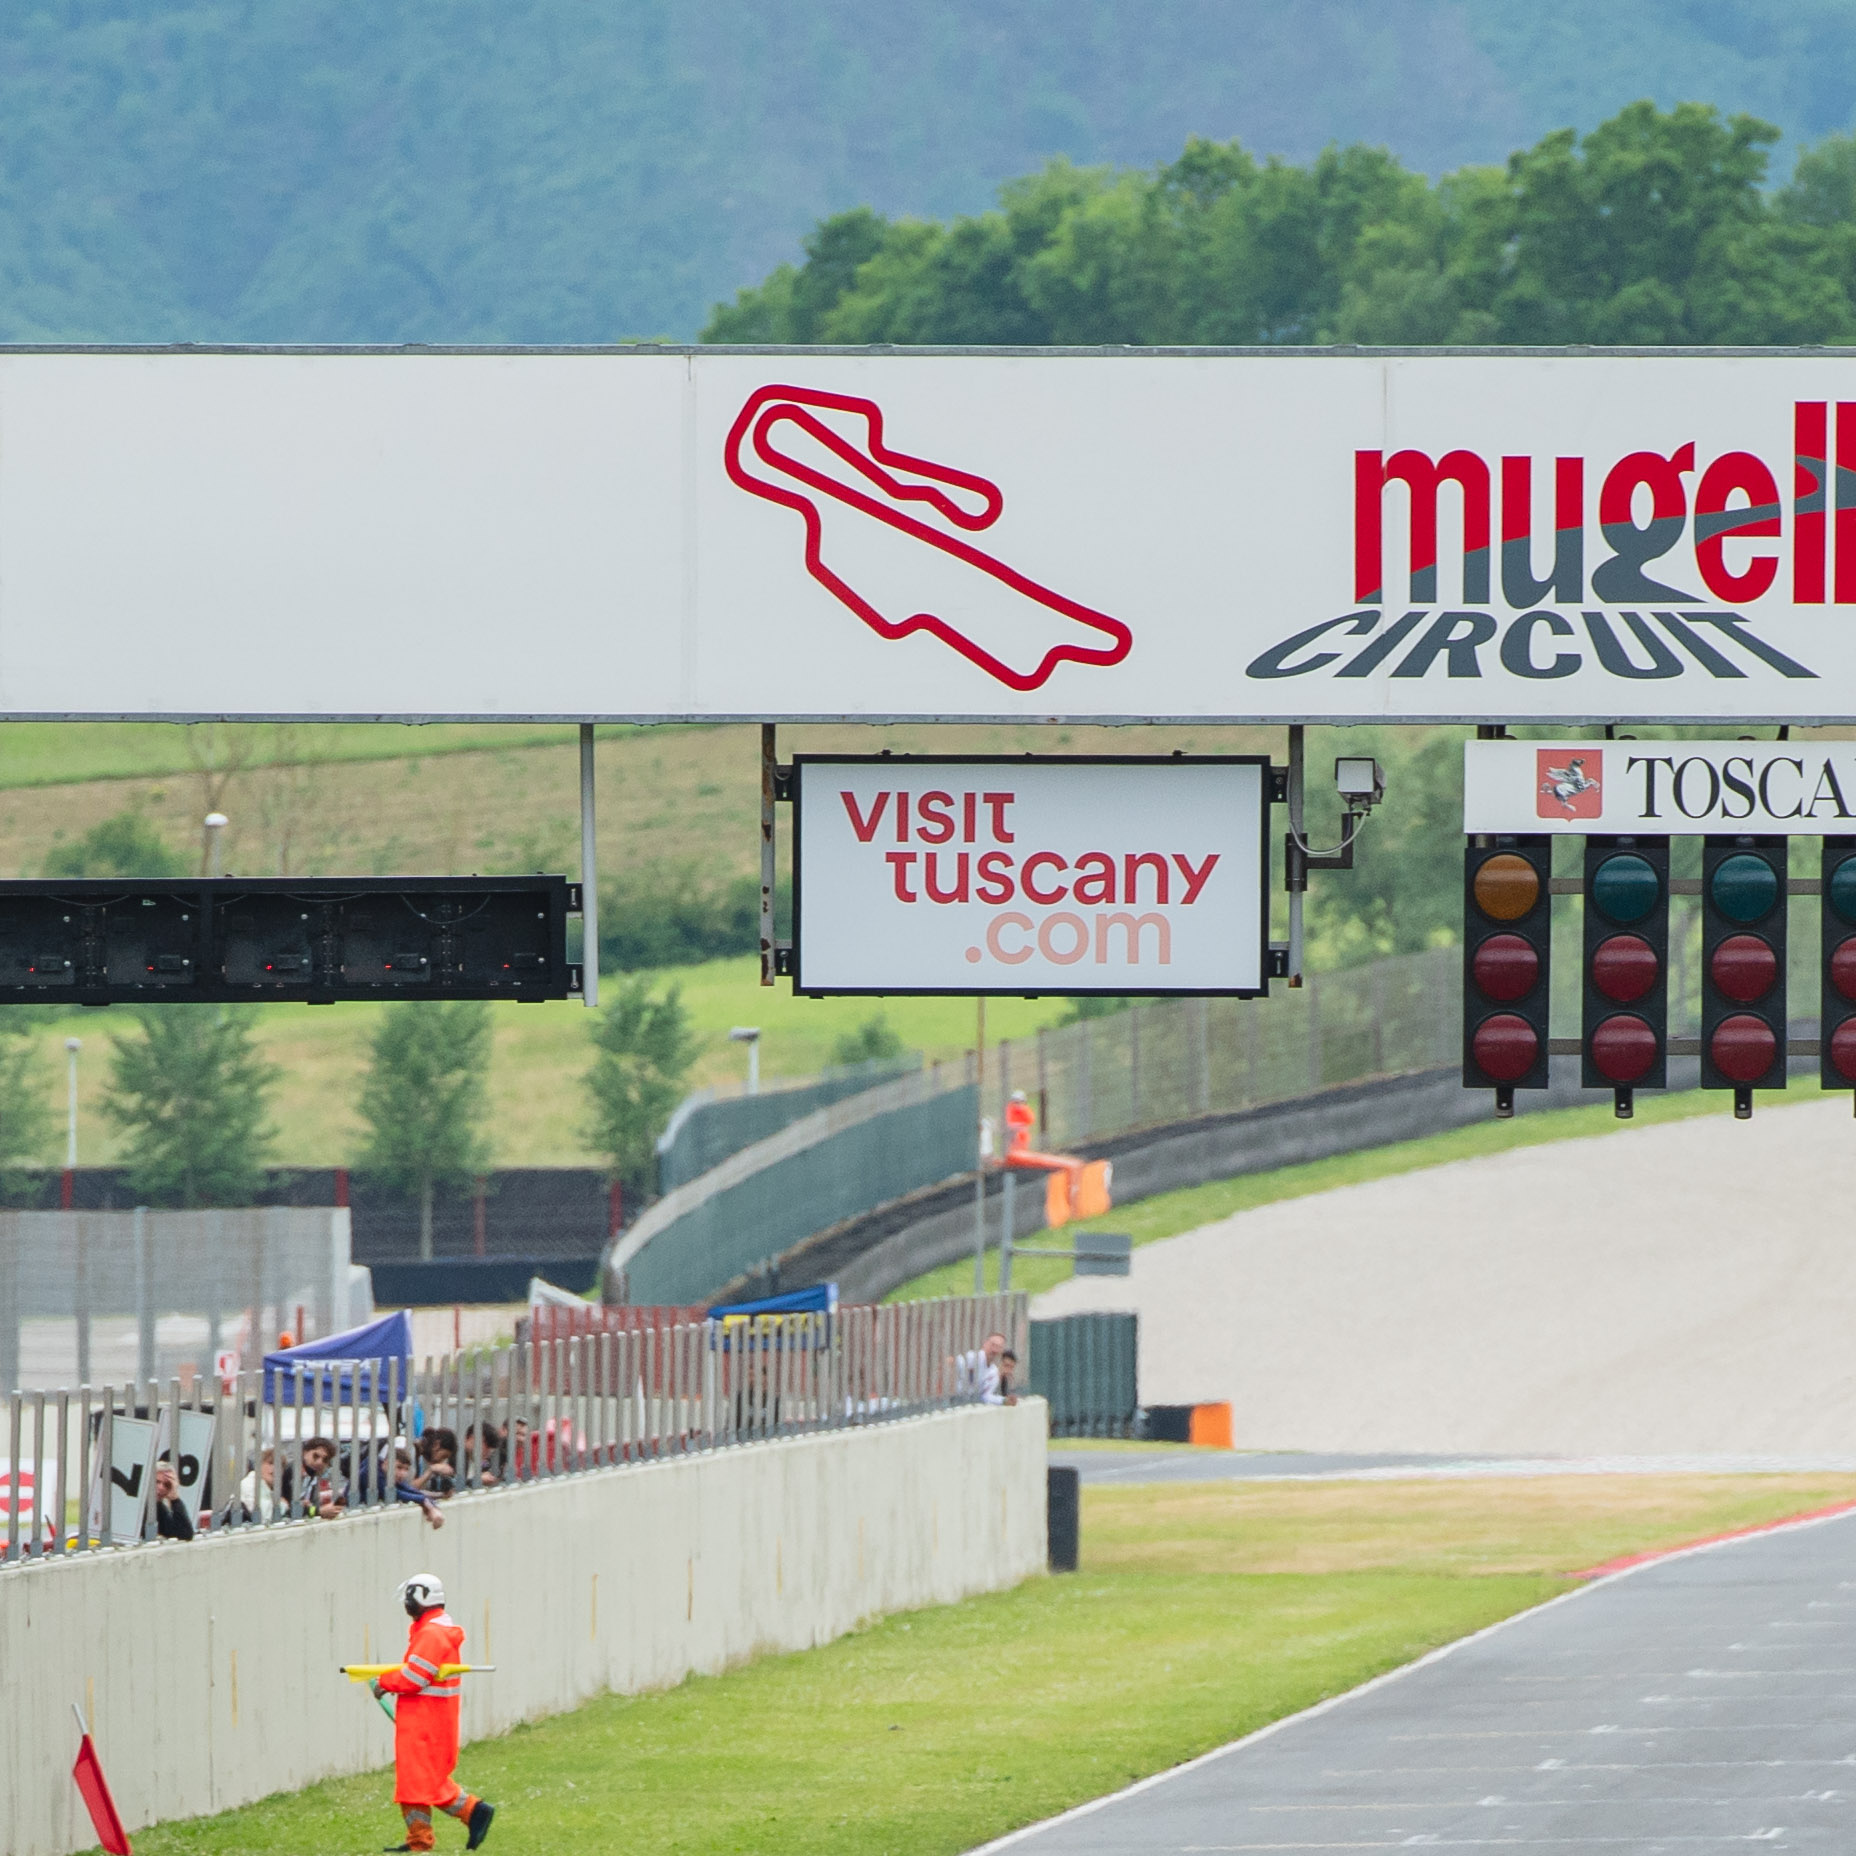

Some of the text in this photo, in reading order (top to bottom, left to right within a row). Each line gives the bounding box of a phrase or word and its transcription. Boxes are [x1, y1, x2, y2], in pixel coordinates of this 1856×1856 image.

[1245, 610, 1822, 679] CIRCUIT
[839, 790, 1015, 844] VISIT
[885, 850, 1221, 905] tuscany
[965, 910, 1172, 966] .com
